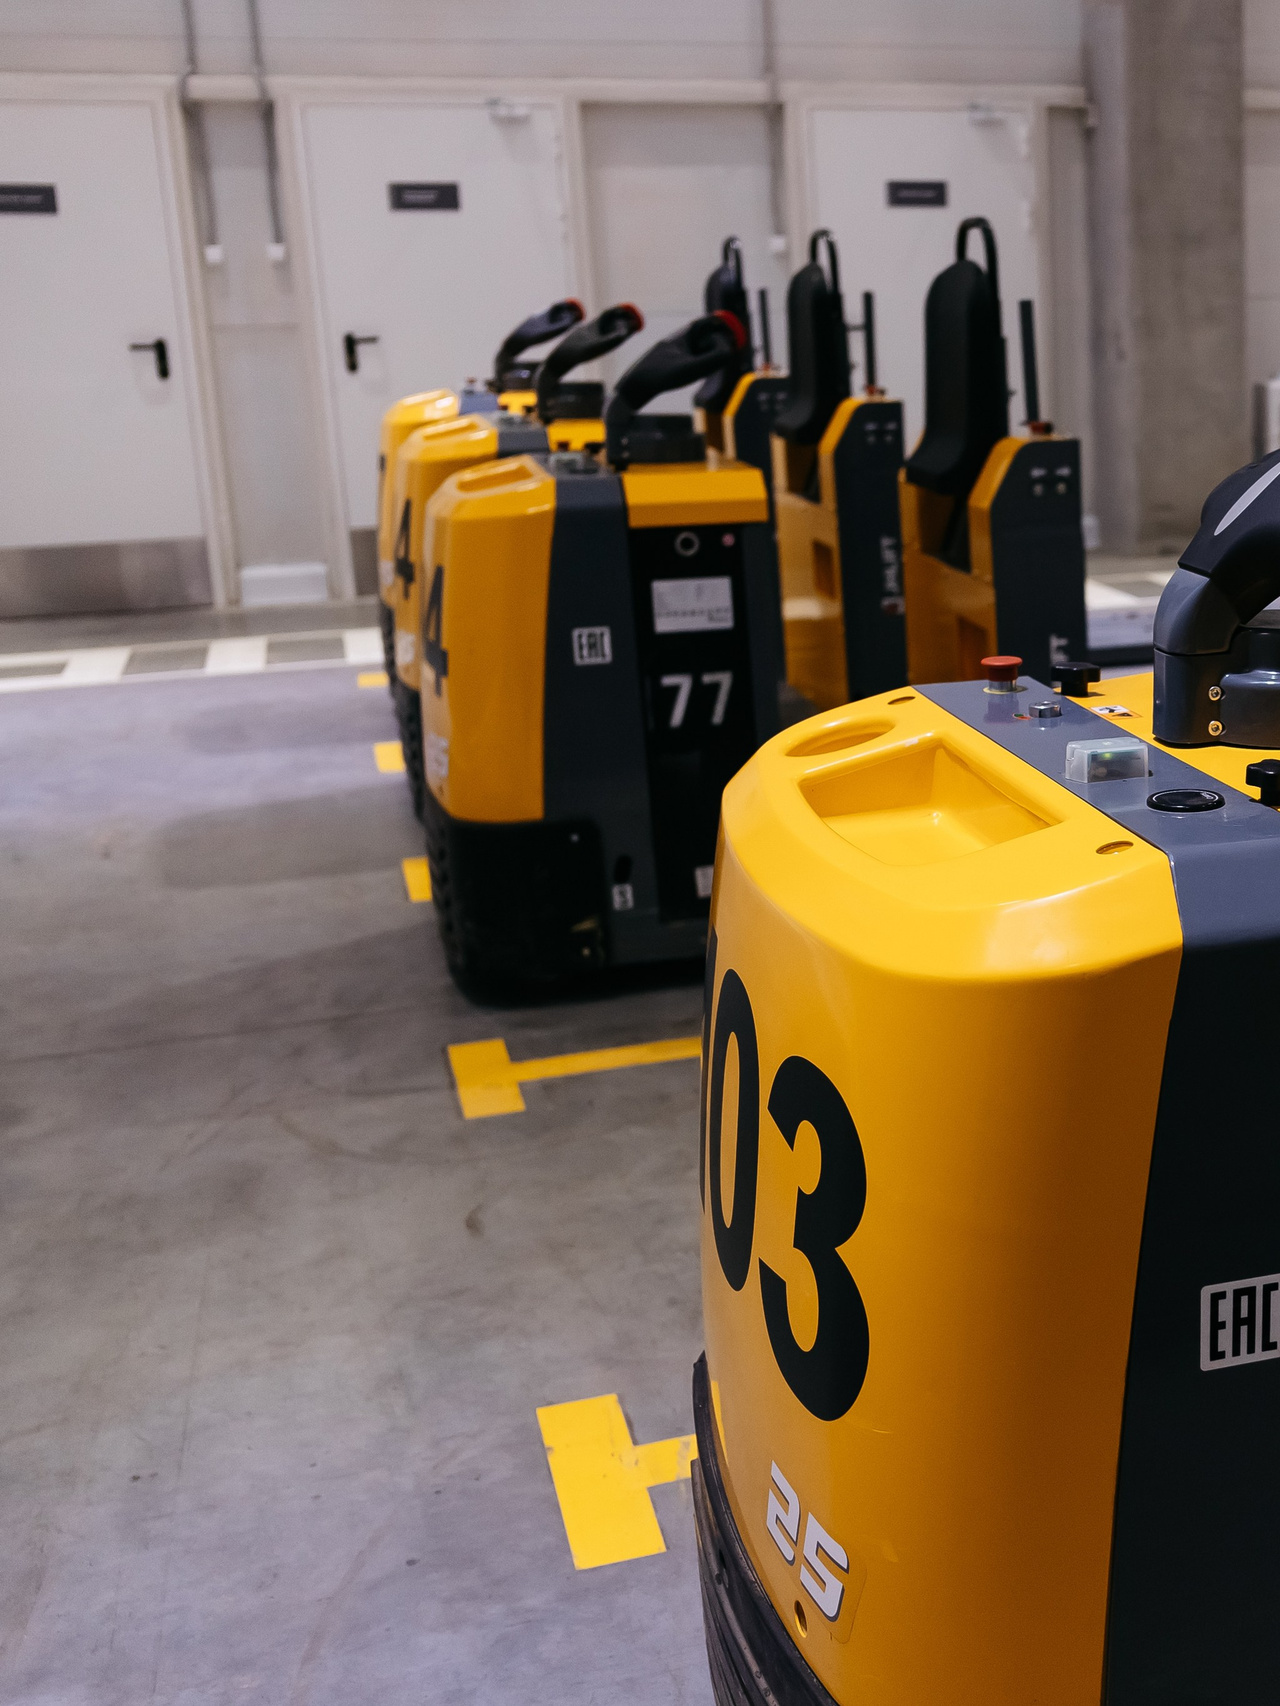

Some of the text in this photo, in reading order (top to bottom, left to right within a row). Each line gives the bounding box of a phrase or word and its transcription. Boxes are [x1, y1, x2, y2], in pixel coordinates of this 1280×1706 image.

[661, 672, 732, 727] 77
[701, 925, 869, 1422] 03
[1209, 1282, 1279, 1362] EAC
[766, 1460, 849, 1623] 25
